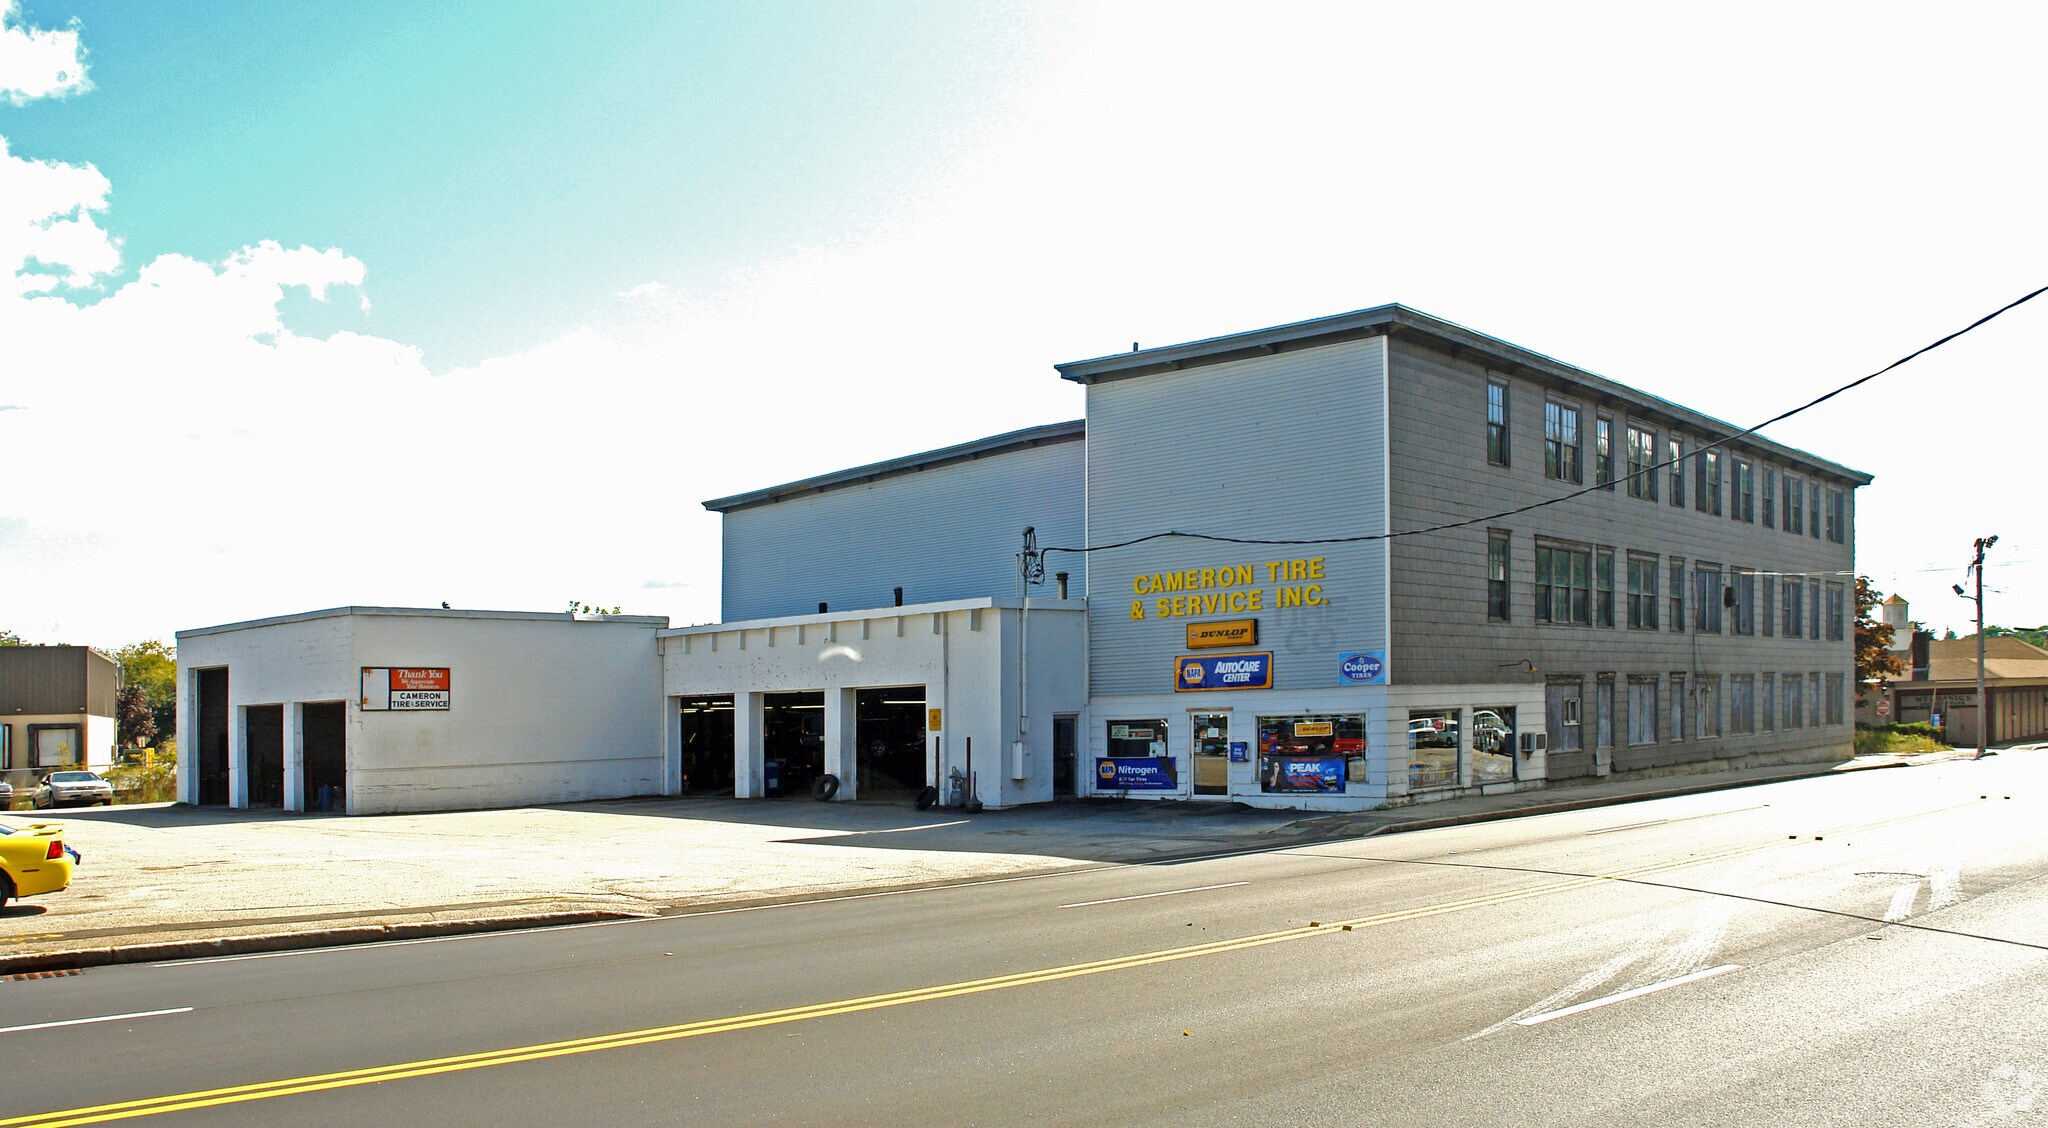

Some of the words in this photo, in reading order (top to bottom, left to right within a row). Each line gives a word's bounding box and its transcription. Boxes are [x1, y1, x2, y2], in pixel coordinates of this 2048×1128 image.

[1133, 564, 1254, 595] CAMERON
[1265, 557, 1325, 582] TIRE
[1130, 600, 1146, 620] &
[1156, 589, 1264, 618] SERVICE
[1276, 584, 1329, 609] INC.
[1200, 628, 1248, 638] DUNLOP
[1344, 662, 1380, 673] Cooper
[397, 669, 427, 679] Thank
[429, 669, 443, 679] You
[1186, 668, 1202, 678] NAPA
[1223, 673, 1251, 683] CENTER
[1118, 765, 1158, 776] Nitrogen
[1289, 763, 1321, 773] PEAK
